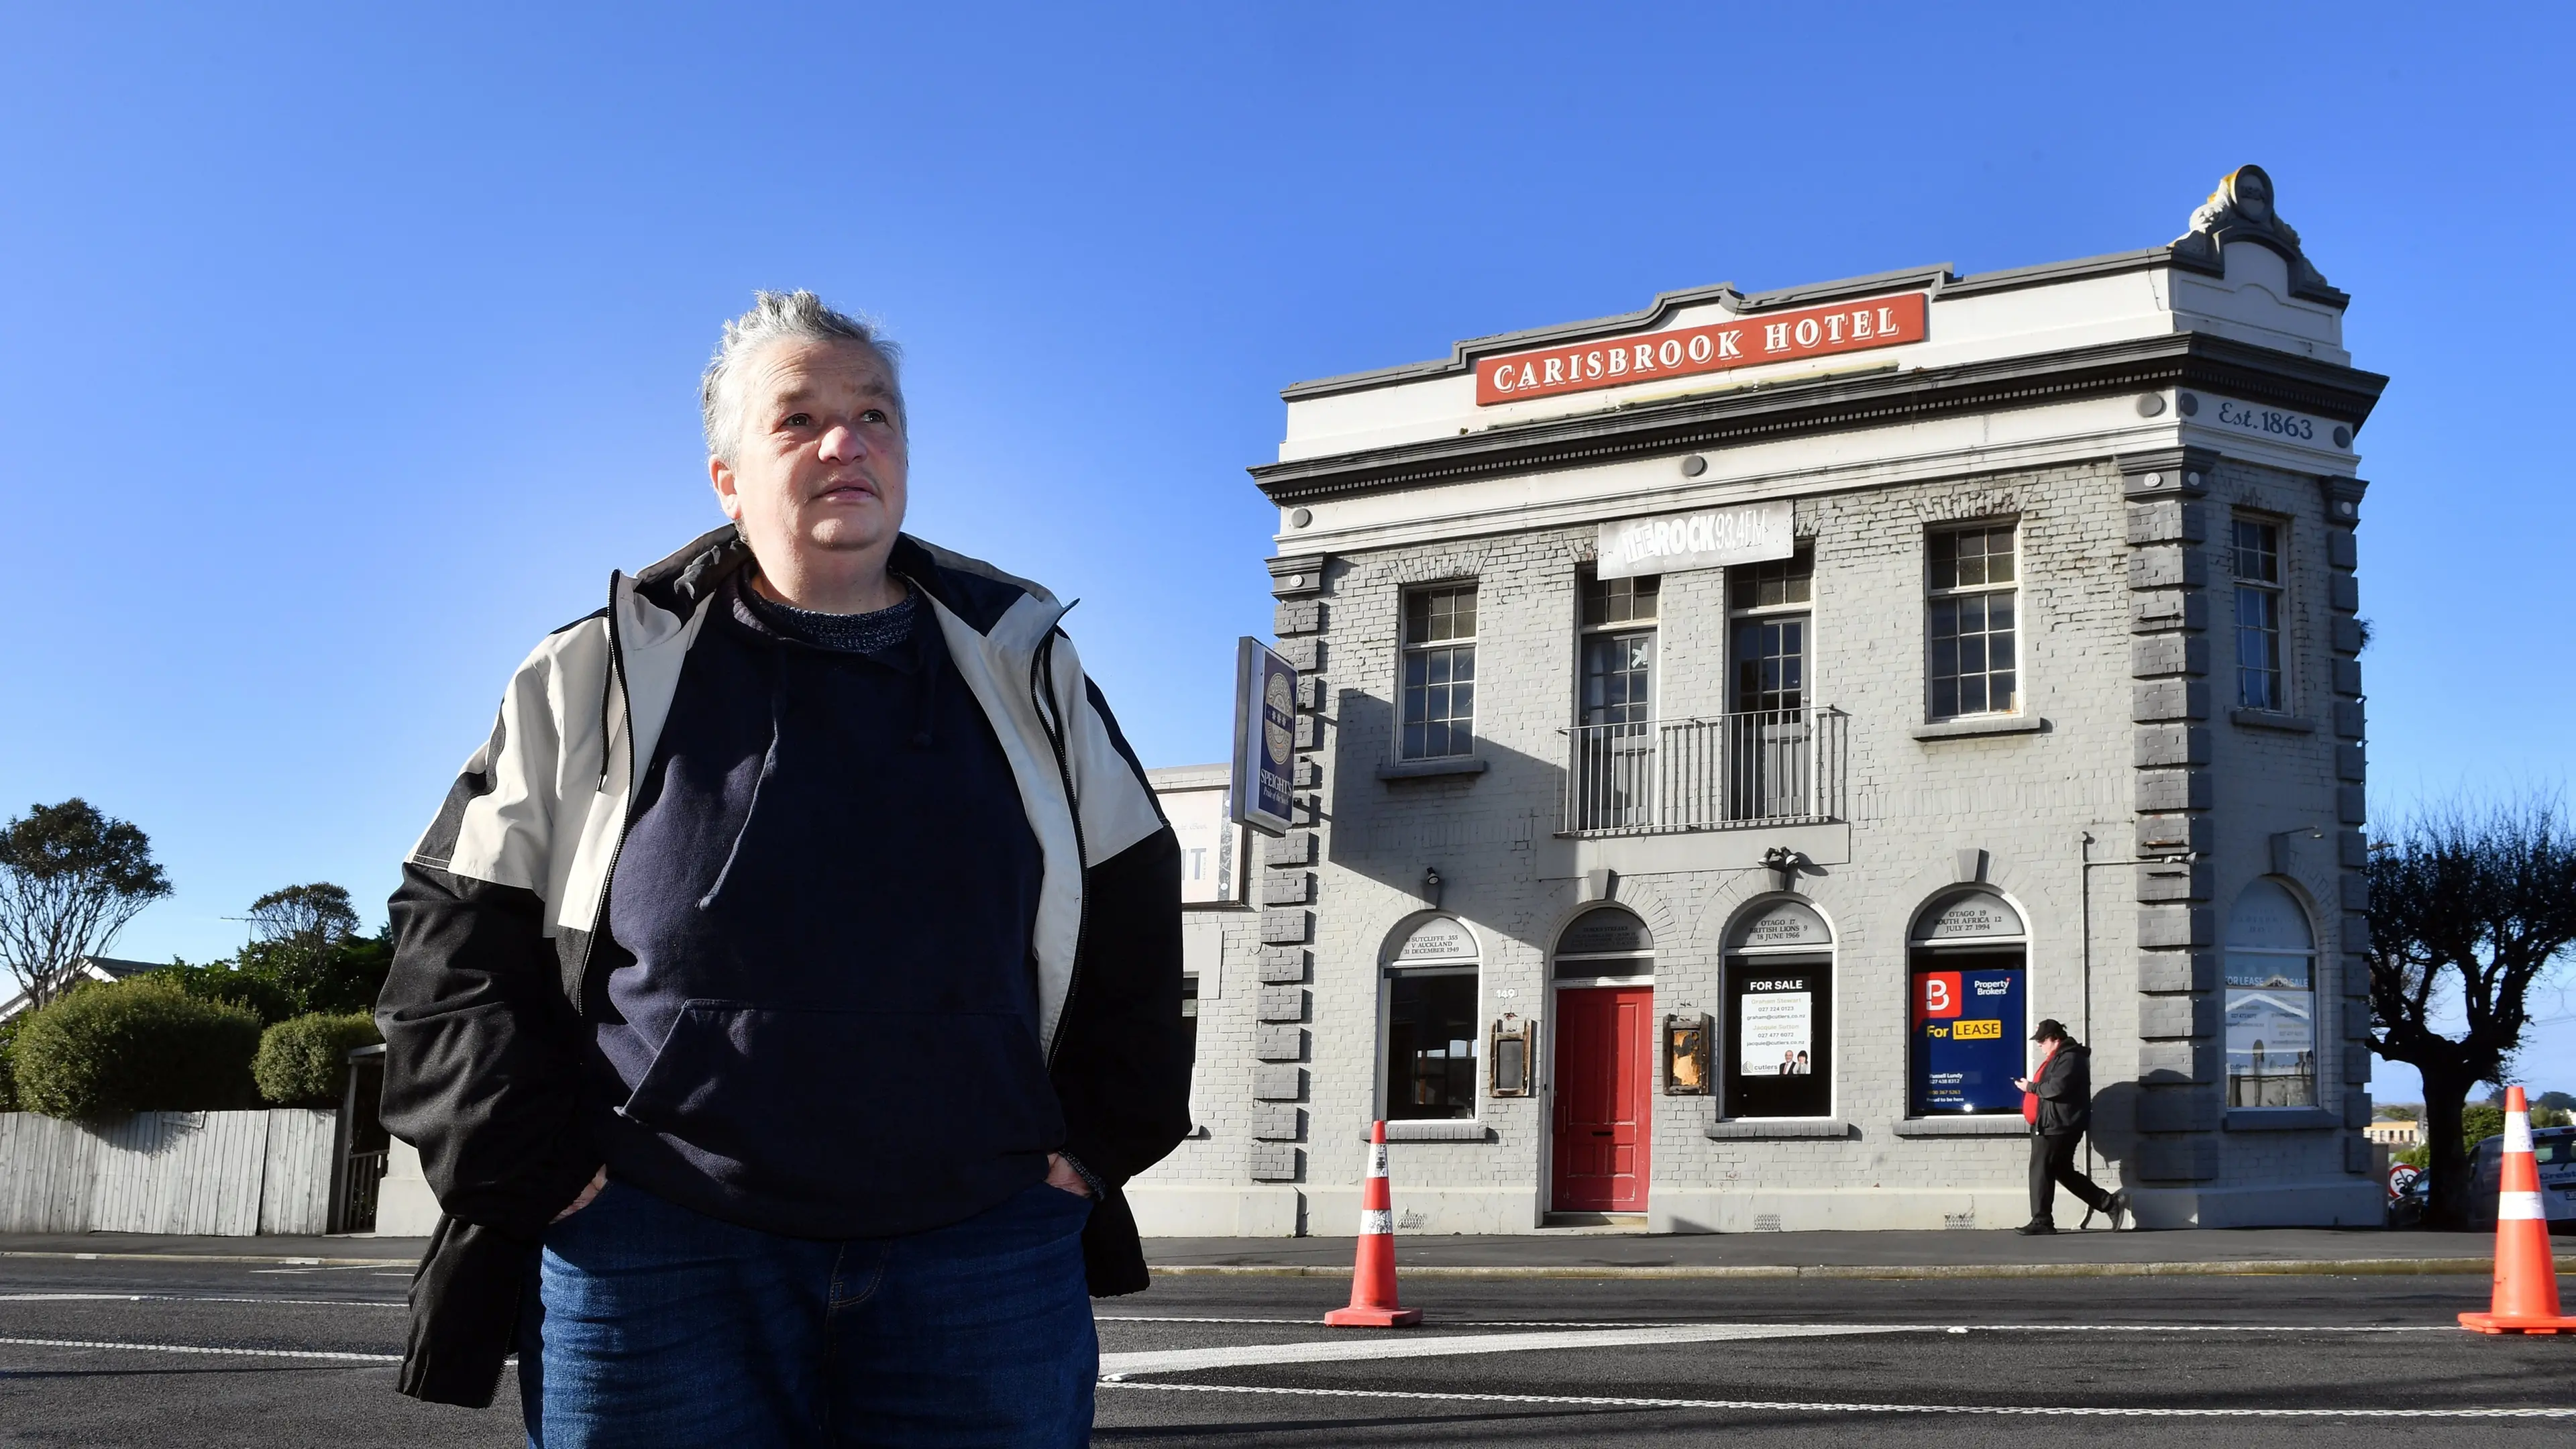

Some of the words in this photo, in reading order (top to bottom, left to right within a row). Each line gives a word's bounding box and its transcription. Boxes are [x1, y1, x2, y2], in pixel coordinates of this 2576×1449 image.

[1493, 329, 1744, 392] CARISBROOK
[1764, 306, 1899, 354] HOTEL
[1653, 514, 1717, 557] ROCK
[1962, 916, 1990, 924] AFRICA
[1945, 925, 1964, 933] JULY
[1764, 933, 1784, 941] JUNE
[1750, 981, 1772, 991] FOR
[1774, 980, 1803, 989] SALE
[1974, 980, 2009, 989] Property
[2239, 976, 2264, 986] LEASE
[2273, 977, 2288, 987] FOR
[2288, 977, 2308, 987] SALE
[1496, 989, 1515, 999] 149
[1977, 987, 2007, 996] Brokers
[1927, 1026, 1949, 1038] For
[1955, 1023, 1999, 1035] LEASE
